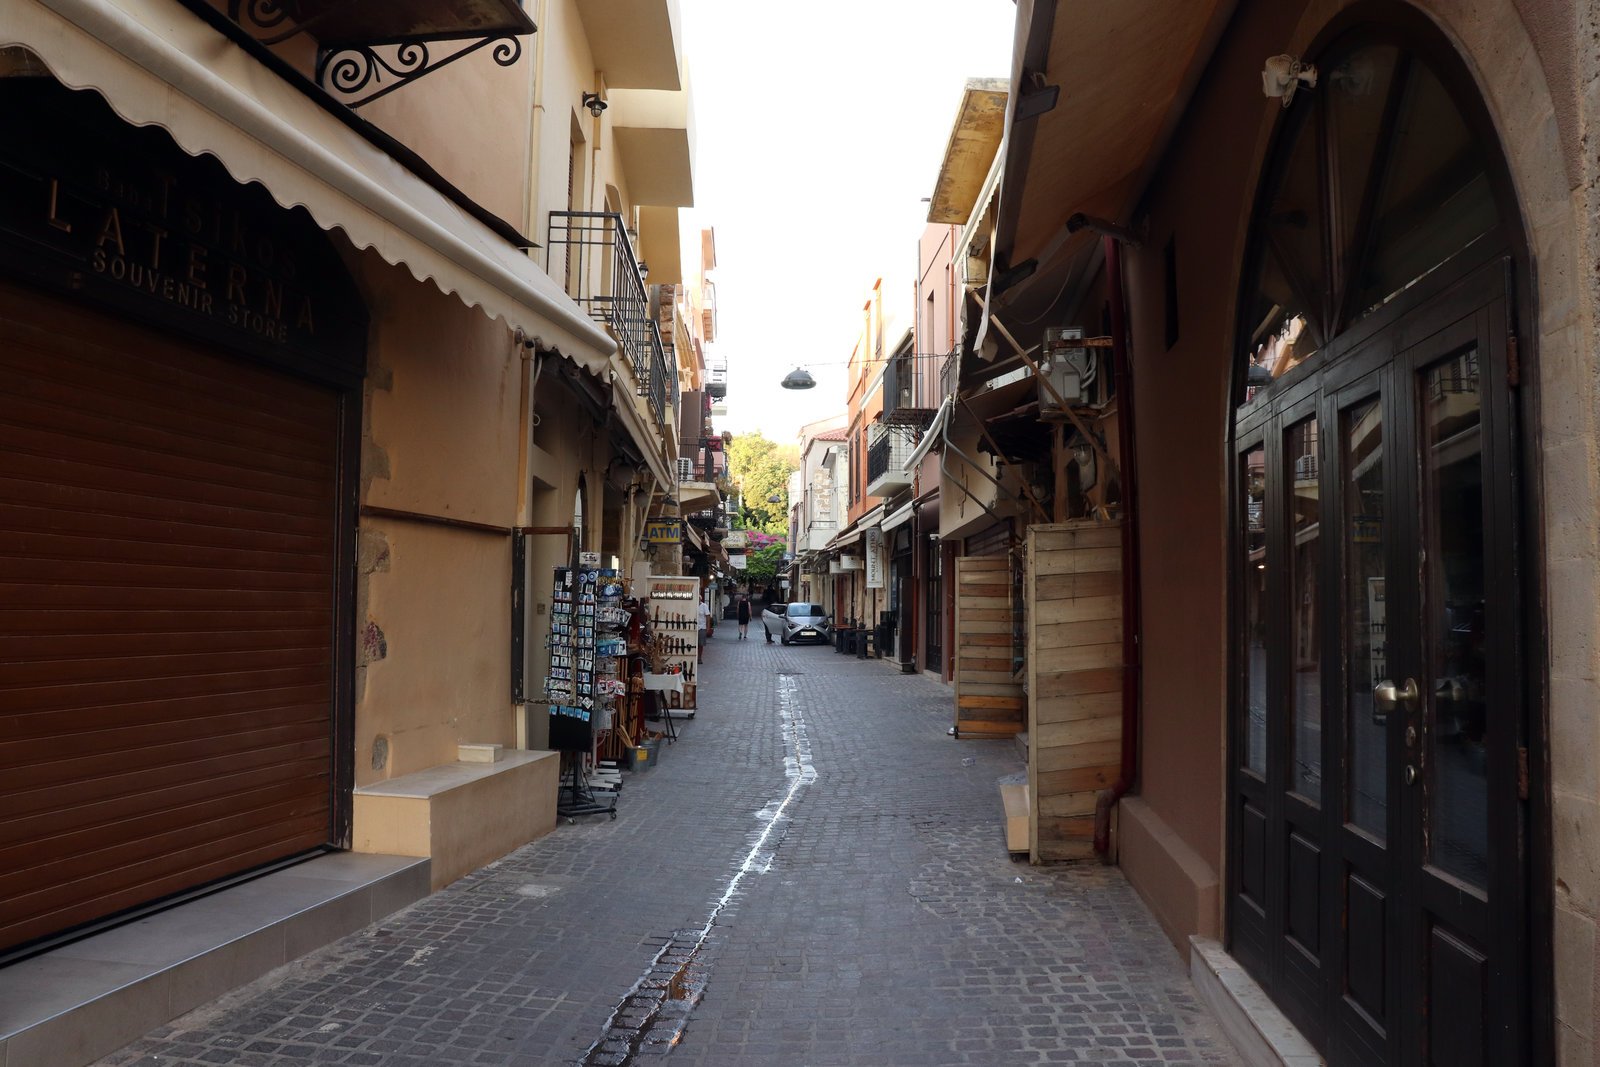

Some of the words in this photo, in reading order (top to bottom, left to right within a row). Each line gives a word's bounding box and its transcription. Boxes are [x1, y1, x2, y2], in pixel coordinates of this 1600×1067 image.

[46, 176, 316, 335] LATERNA
[92, 249, 214, 316] SOUVENIR
[227, 304, 288, 344] STORE
[650, 527, 679, 538] ATM
